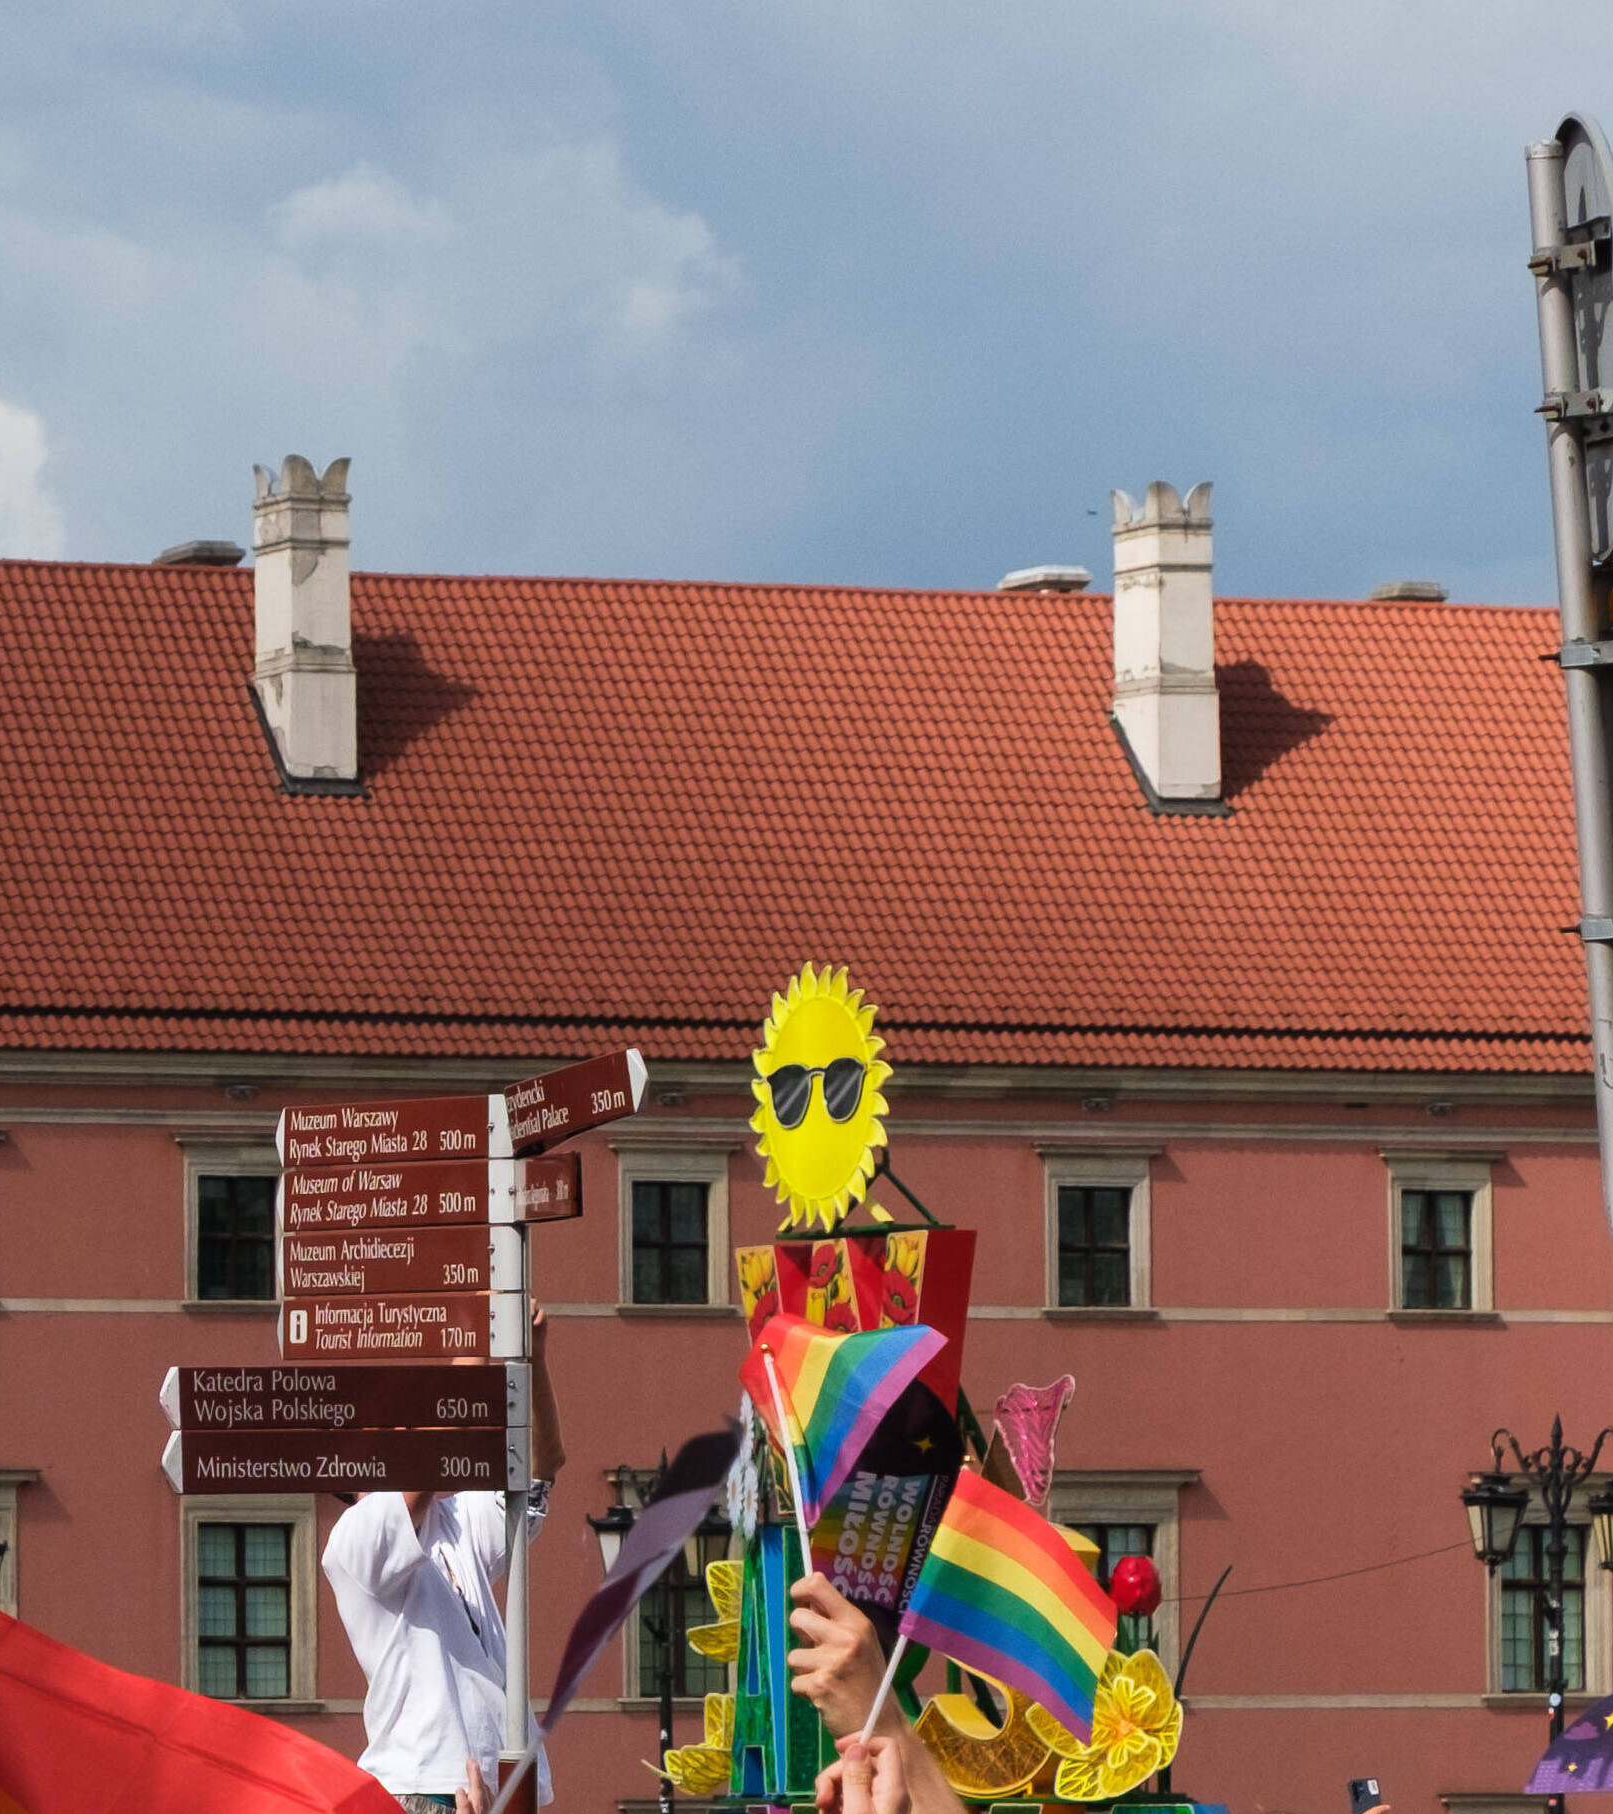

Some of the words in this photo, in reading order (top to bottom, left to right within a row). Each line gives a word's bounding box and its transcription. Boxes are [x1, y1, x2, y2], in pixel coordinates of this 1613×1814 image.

[590, 1089, 612, 1114] 350
[613, 1091, 626, 1108] m
[290, 1110, 337, 1131] Muzeum
[342, 1107, 399, 1133] Warszawy
[542, 1103, 570, 1130] Palace
[289, 1136, 322, 1165] Rynek
[325, 1137, 367, 1162] Starego
[371, 1132, 408, 1154] Miasta
[412, 1130, 428, 1151] 28
[439, 1129, 462, 1151] 500
[464, 1133, 476, 1150] m
[291, 1174, 338, 1195] Museum
[342, 1170, 356, 1192] of
[358, 1170, 403, 1191] Warsaw
[290, 1200, 322, 1229] Rynek
[326, 1201, 367, 1227] Starego
[370, 1196, 408, 1218] Miasta
[412, 1194, 428, 1215] 28
[439, 1192, 462, 1214] 500
[464, 1196, 476, 1213] m
[290, 1240, 336, 1262] Muzeum
[340, 1237, 415, 1265] Archidiecezji
[290, 1265, 365, 1293] Warszawskiej
[443, 1263, 466, 1285] 350
[467, 1267, 479, 1283] m
[315, 1302, 374, 1330] Informacja
[378, 1302, 447, 1330] Turystyczna
[315, 1328, 353, 1350] Tourist
[356, 1326, 423, 1350] Information
[440, 1327, 463, 1348] 170
[465, 1331, 477, 1347] m
[193, 1368, 263, 1392] Katedra
[272, 1368, 336, 1392] Polowa
[194, 1398, 263, 1427] Wojska
[272, 1399, 355, 1427] Polskiego
[436, 1398, 468, 1419] 650
[472, 1402, 488, 1418] m
[196, 1456, 311, 1479] Ministerstwo
[316, 1455, 387, 1478] Zdrowia
[440, 1456, 471, 1478] 300
[474, 1460, 490, 1478] m
[854, 1475, 899, 1601] RÓWNOŚĆ
[874, 1480, 921, 1603] WOLNOŚĆ
